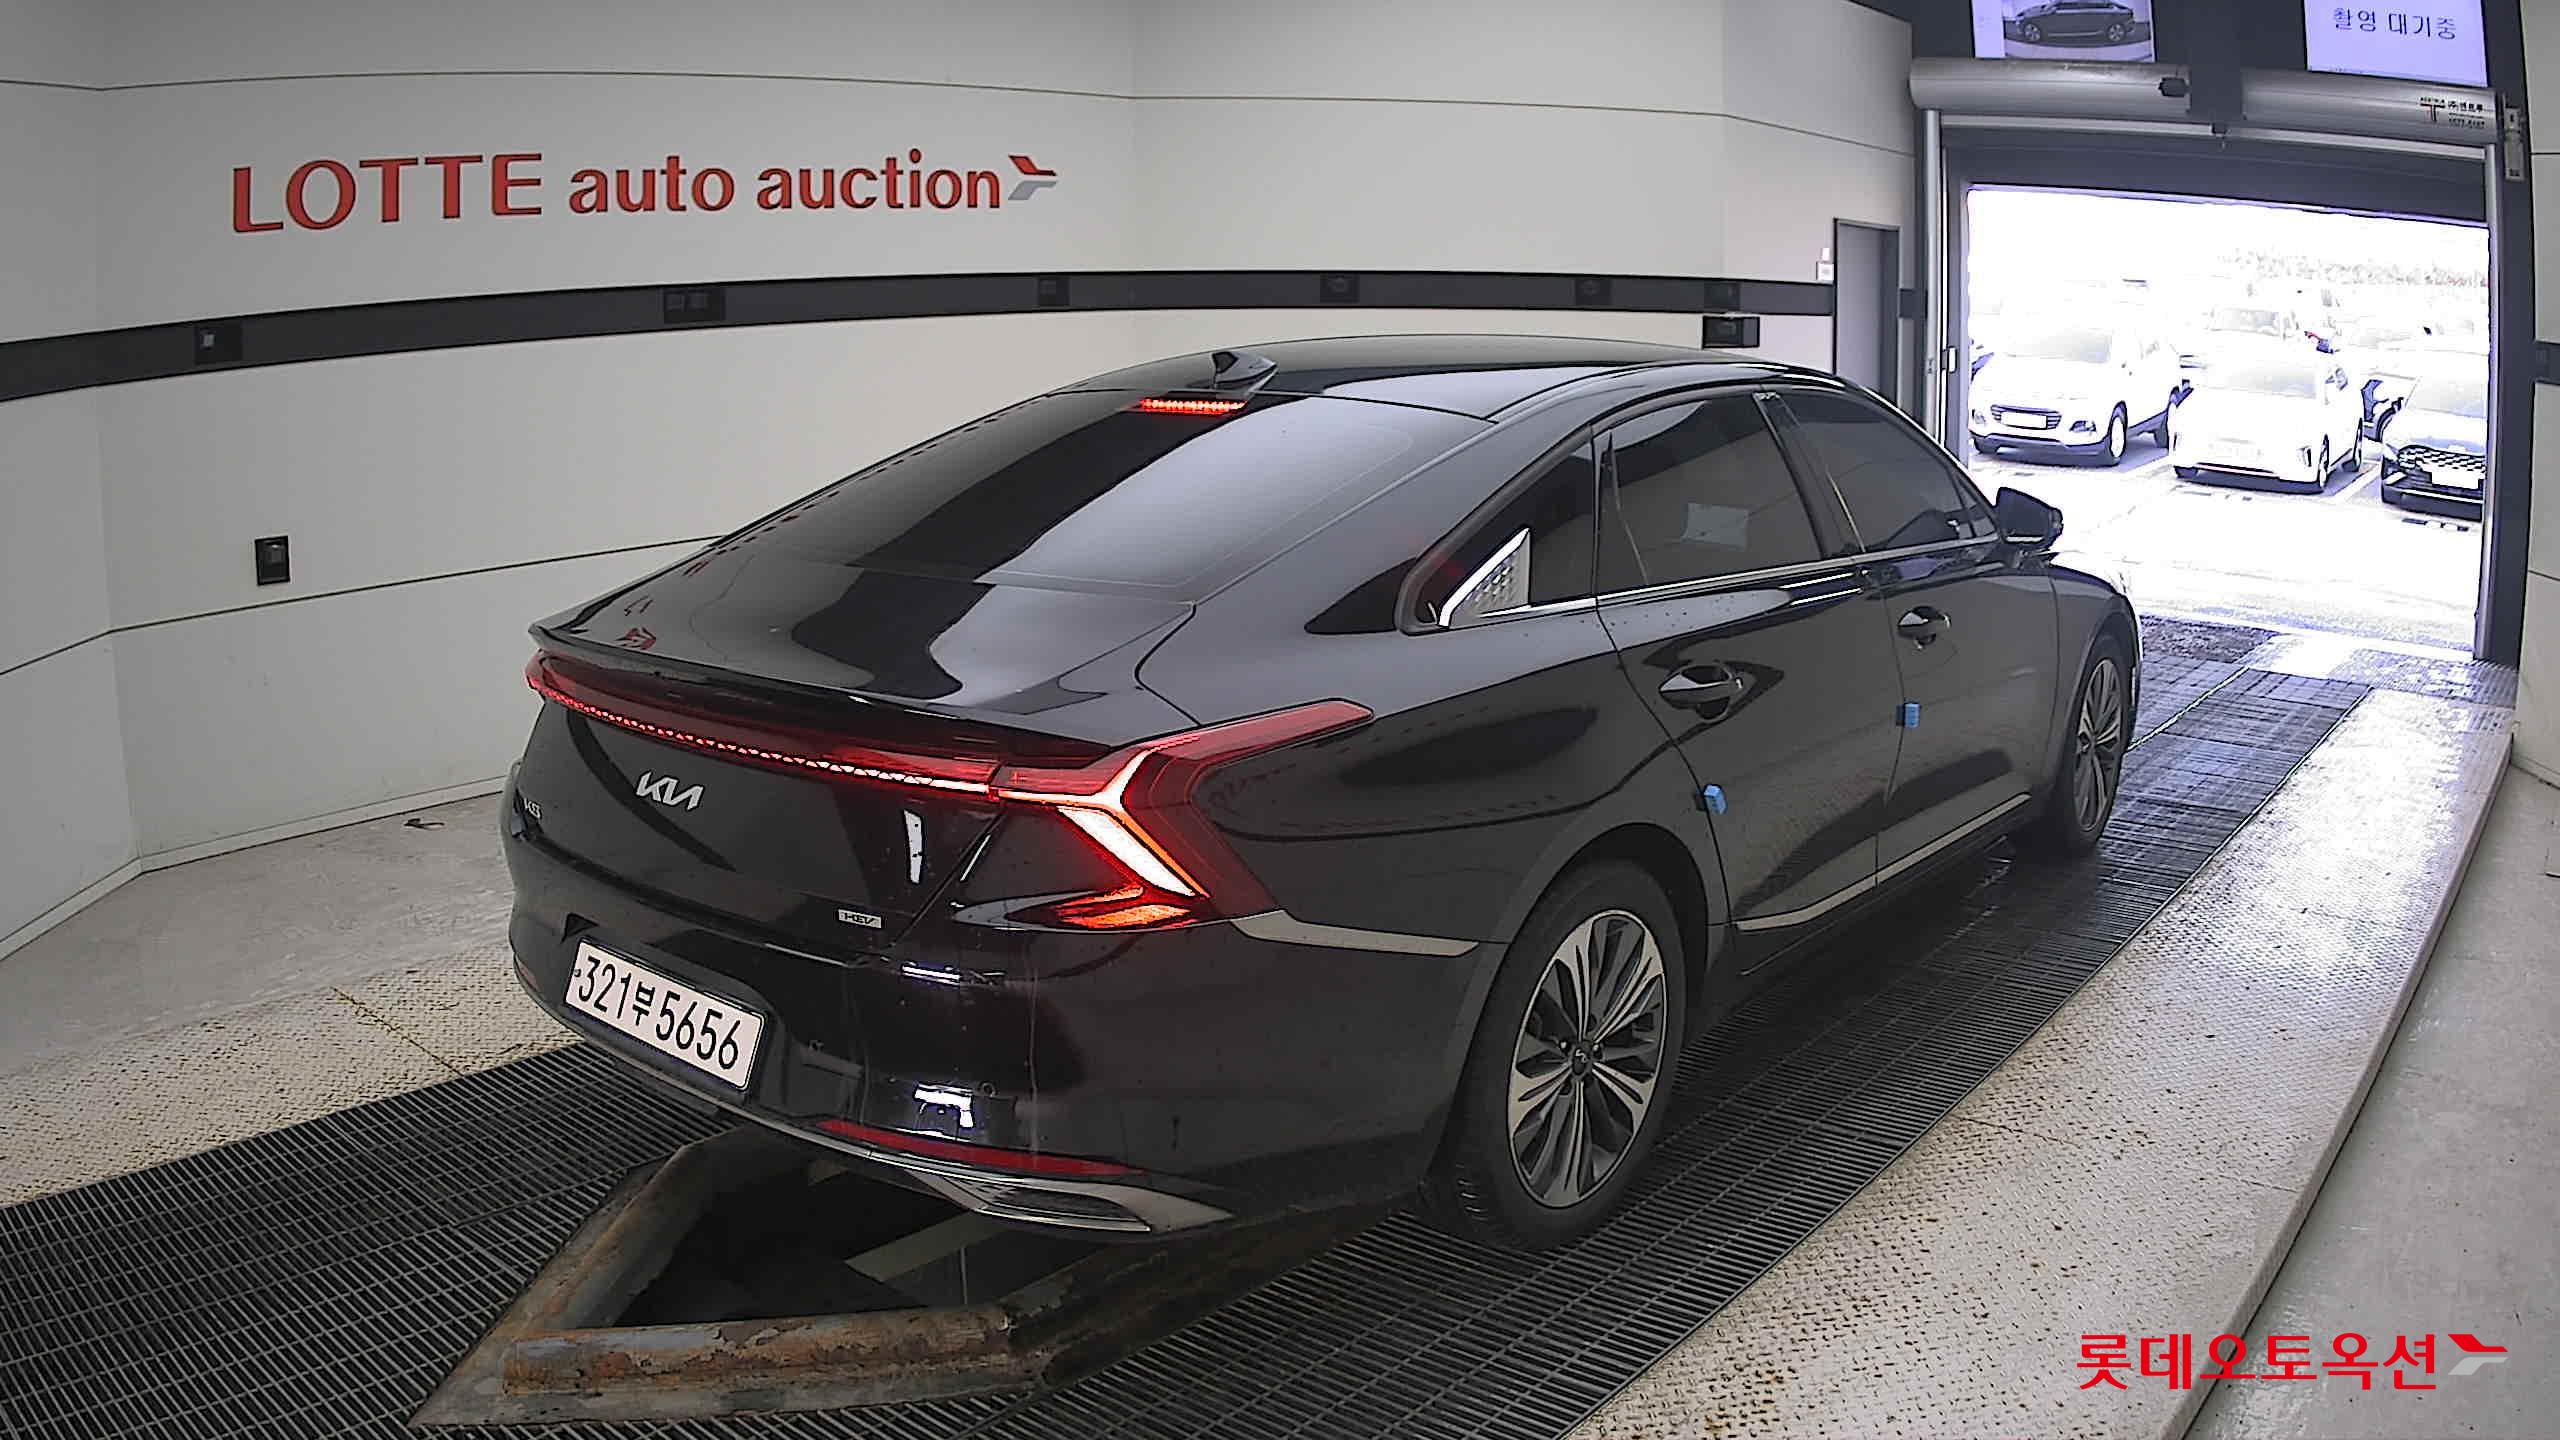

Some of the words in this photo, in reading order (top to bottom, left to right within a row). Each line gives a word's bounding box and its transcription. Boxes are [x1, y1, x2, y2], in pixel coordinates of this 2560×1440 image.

[2334, 7, 2376, 32] 촬영
[2388, 13, 2456, 40] 대기중
[233, 153, 542, 233] LOTTE
[568, 155, 735, 214] auto
[757, 148, 1001, 209] auction
[577, 955, 741, 1072] 321부5656
